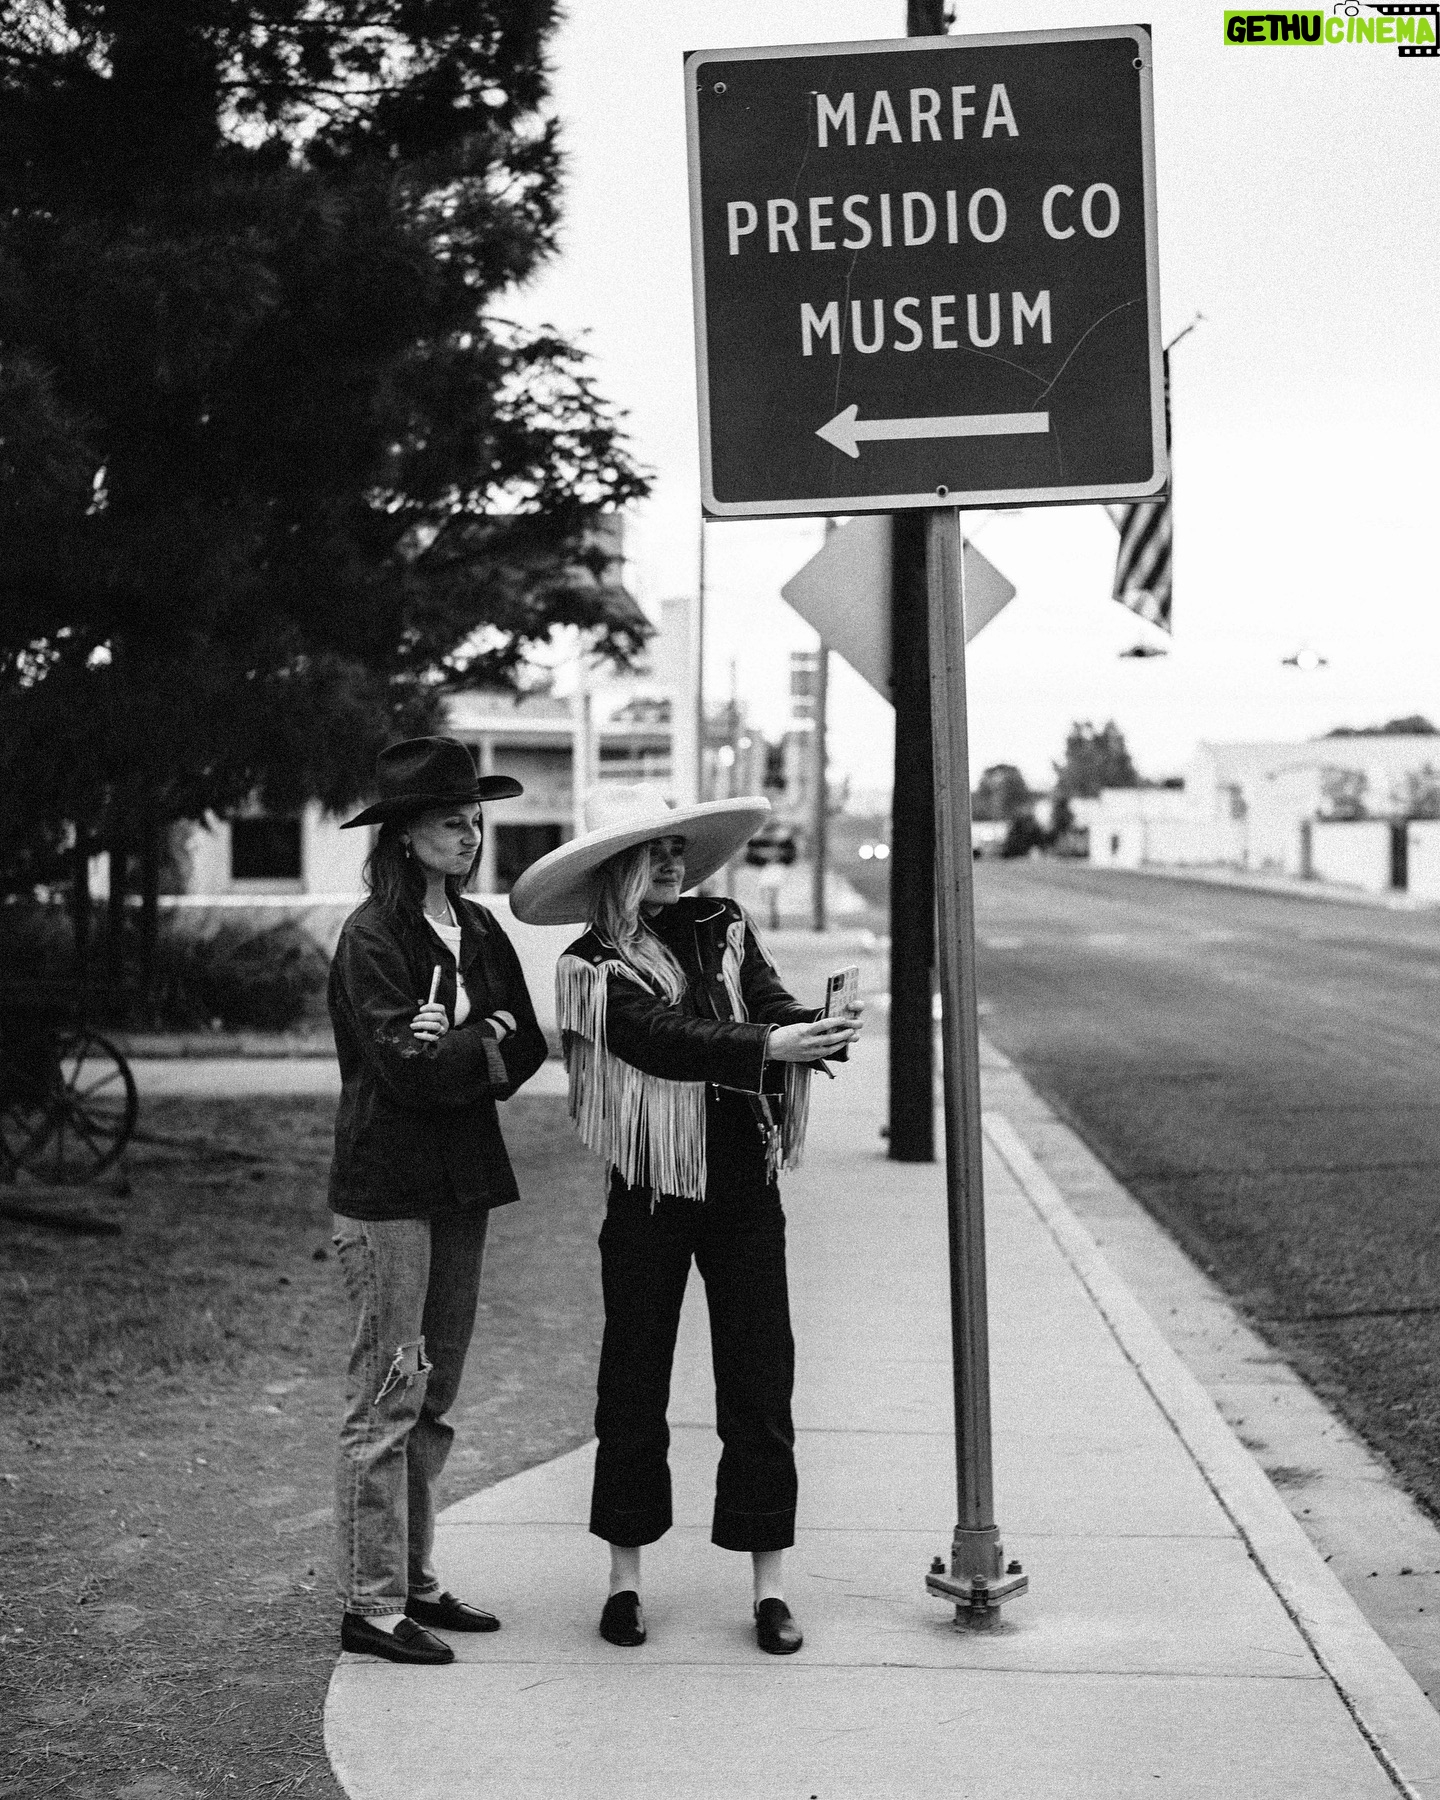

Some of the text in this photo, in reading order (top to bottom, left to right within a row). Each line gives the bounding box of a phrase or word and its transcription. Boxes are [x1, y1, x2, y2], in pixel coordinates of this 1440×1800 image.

[816, 82, 1020, 148] MARFA
[726, 182, 1121, 256] PRESIDIO CO
[799, 289, 1054, 357] MUSEUM
